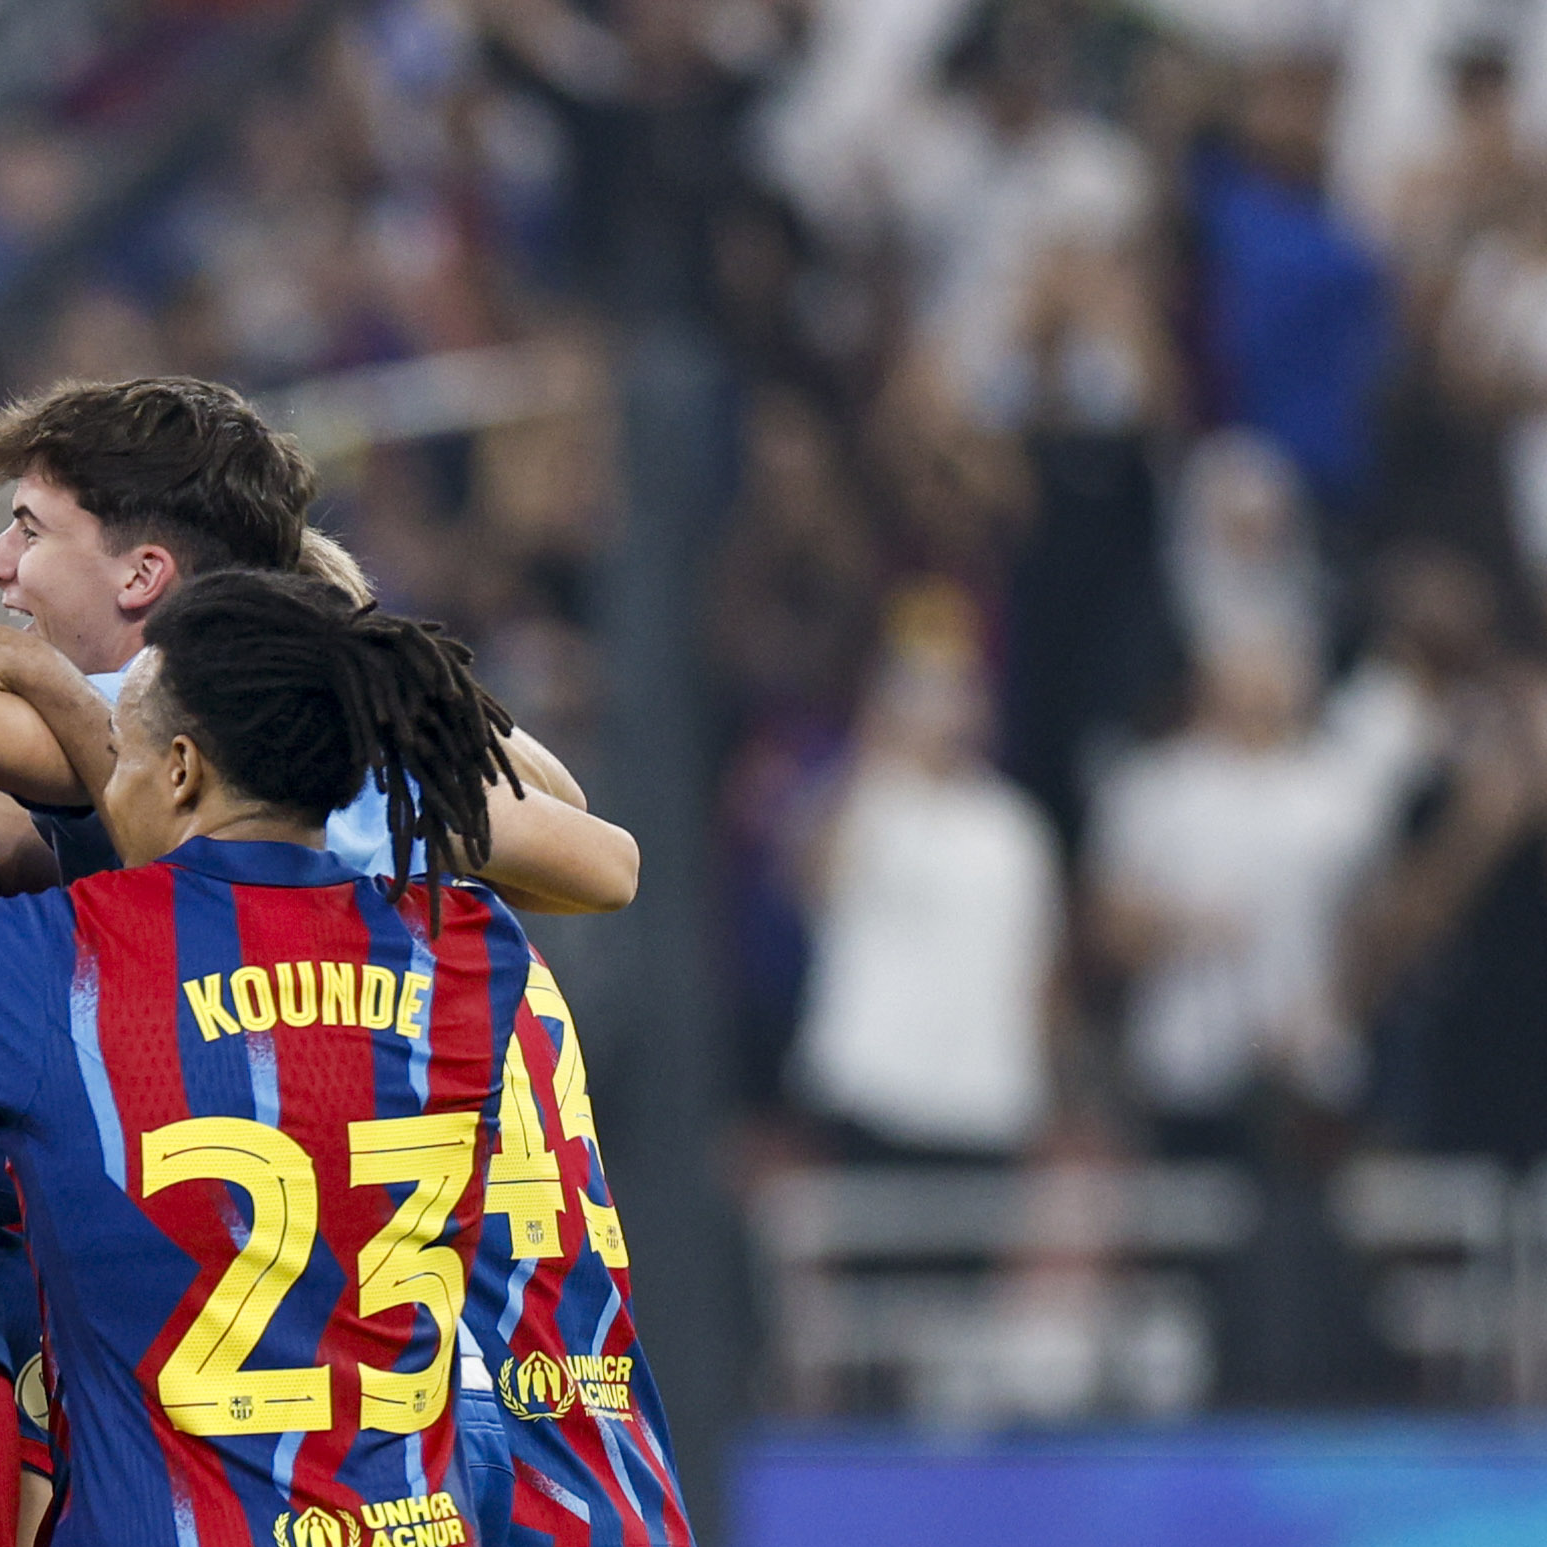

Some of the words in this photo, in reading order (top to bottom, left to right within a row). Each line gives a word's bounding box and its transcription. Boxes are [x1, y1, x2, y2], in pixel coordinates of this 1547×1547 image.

[183, 961, 434, 1042] KOUNDE
[141, 1112, 484, 1436] 23
[566, 1355, 634, 1382] UNHCR
[360, 1491, 459, 1529] UNHCR
